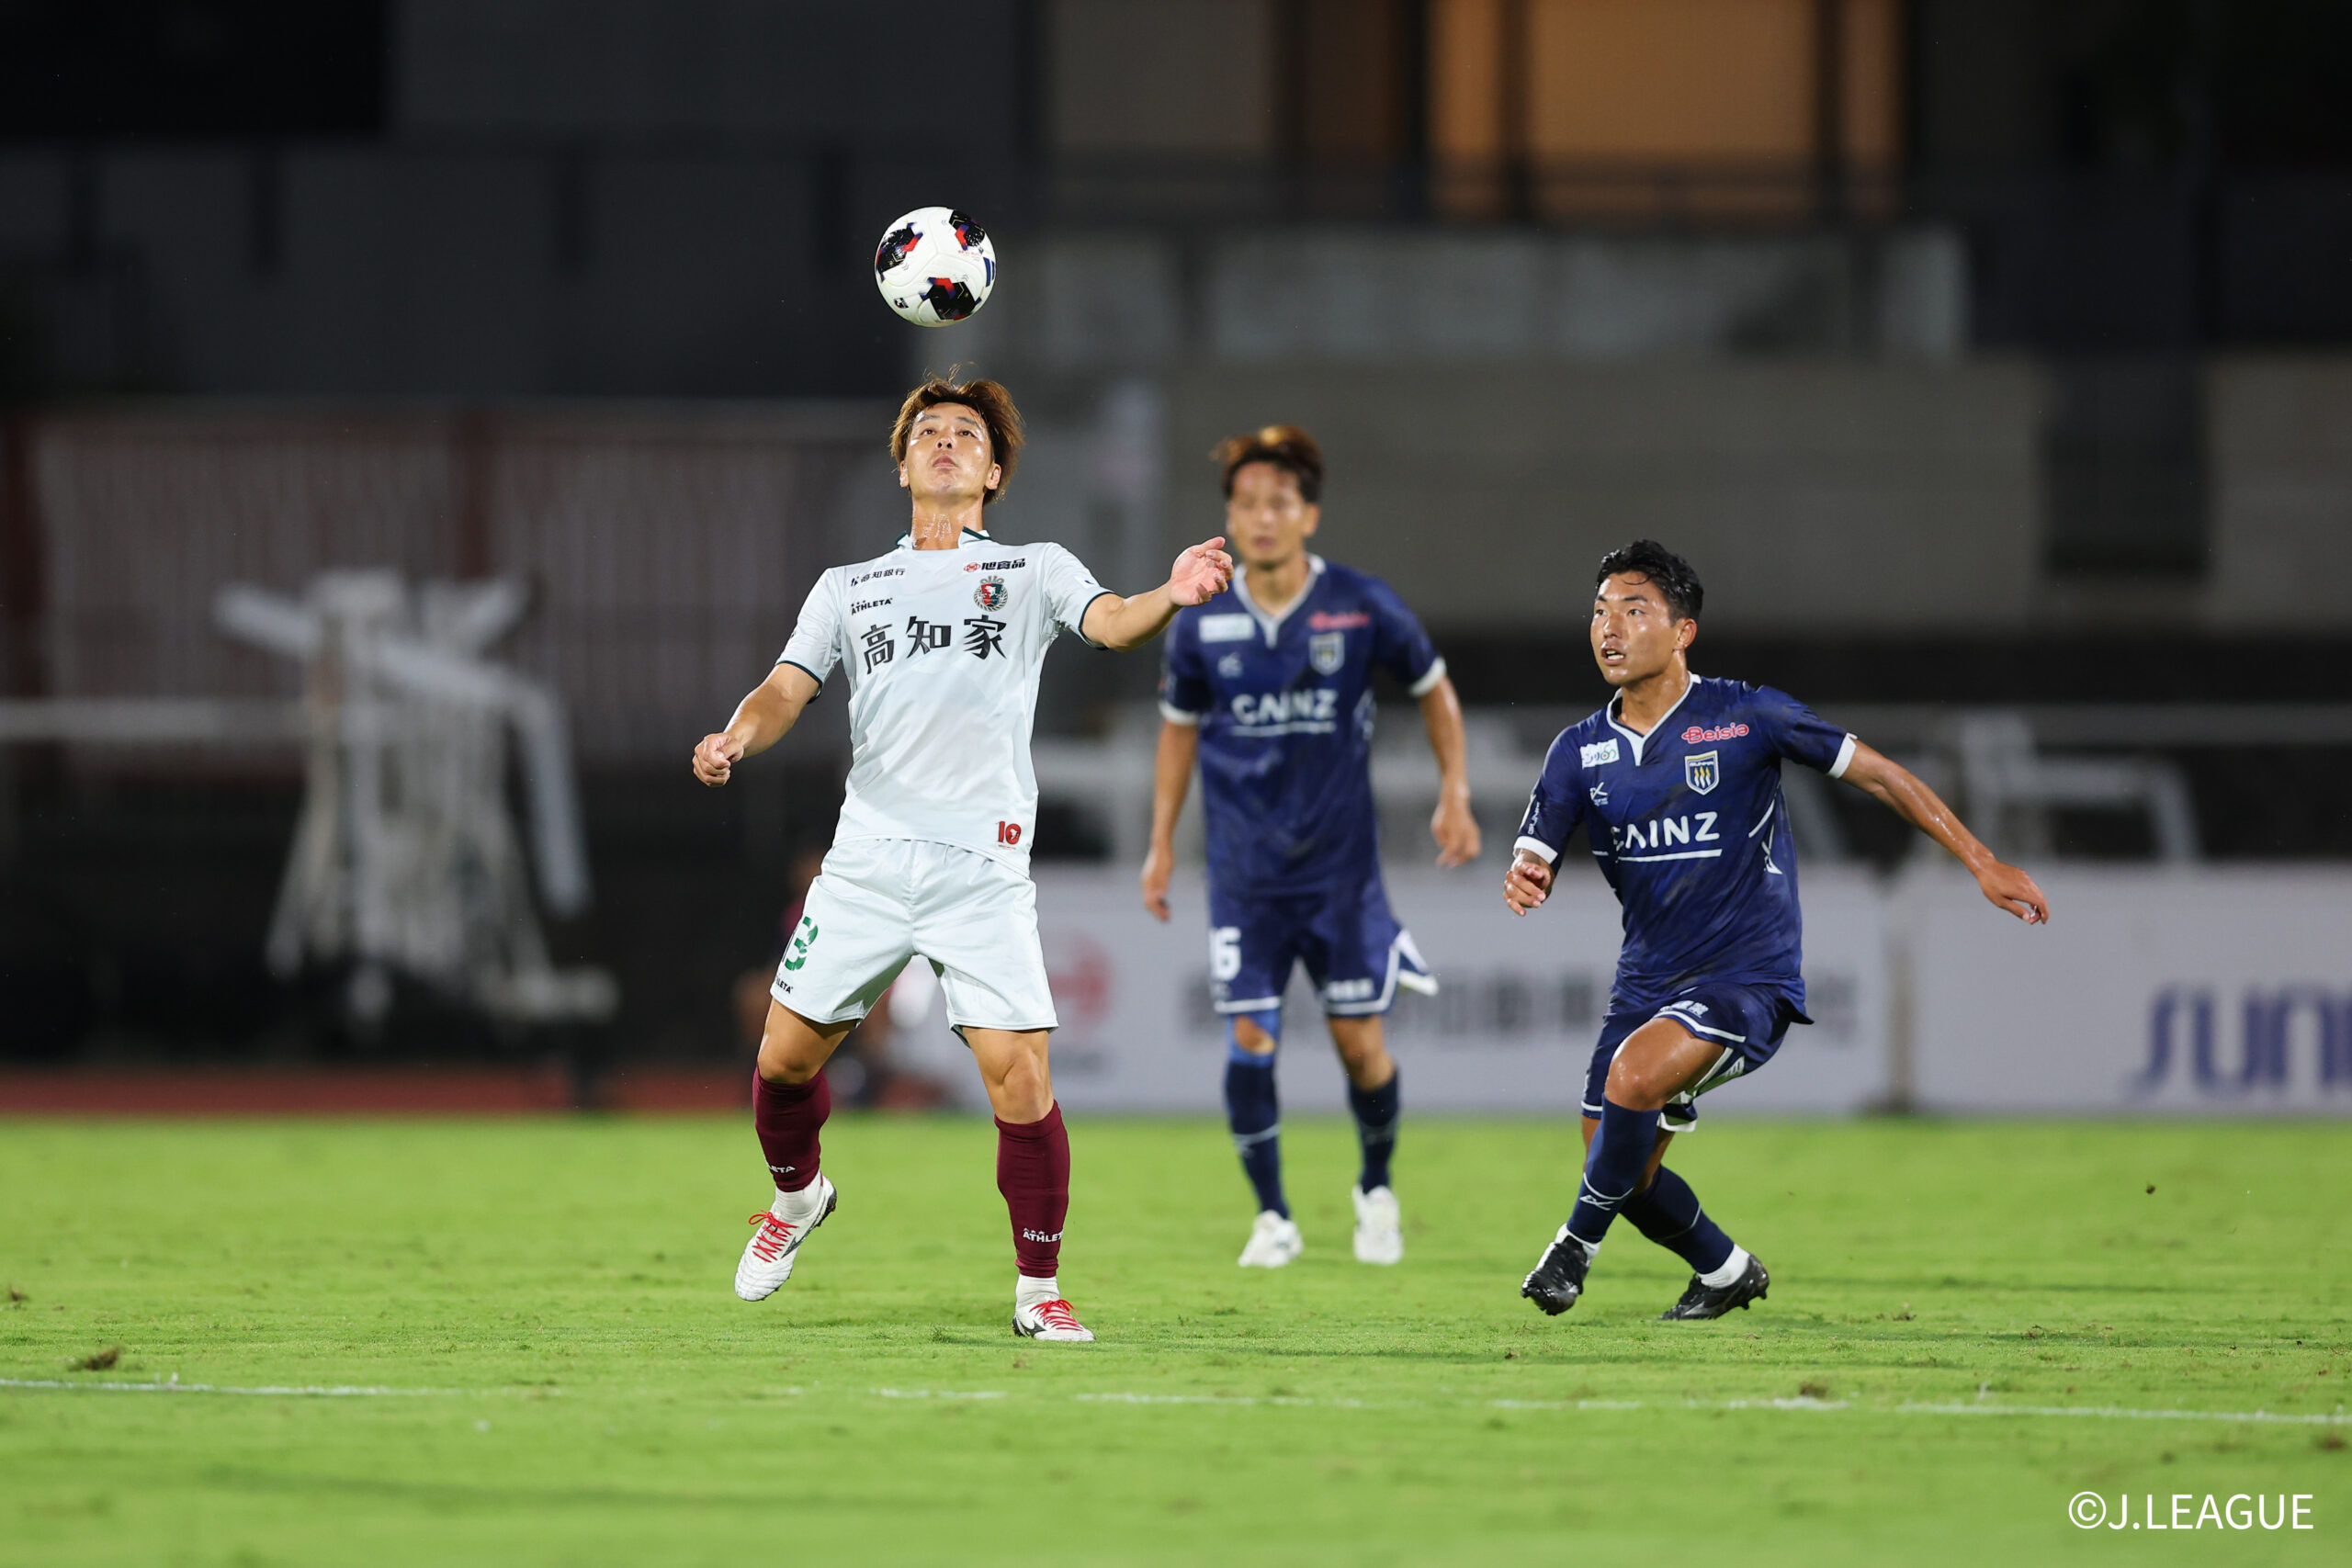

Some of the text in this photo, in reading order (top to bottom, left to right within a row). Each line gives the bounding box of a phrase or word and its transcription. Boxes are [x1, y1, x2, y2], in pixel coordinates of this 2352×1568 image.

[851, 598, 891, 615] ATHLETA
[861, 615, 1007, 675] 高知家
[1680, 722, 1749, 744] Beisia
